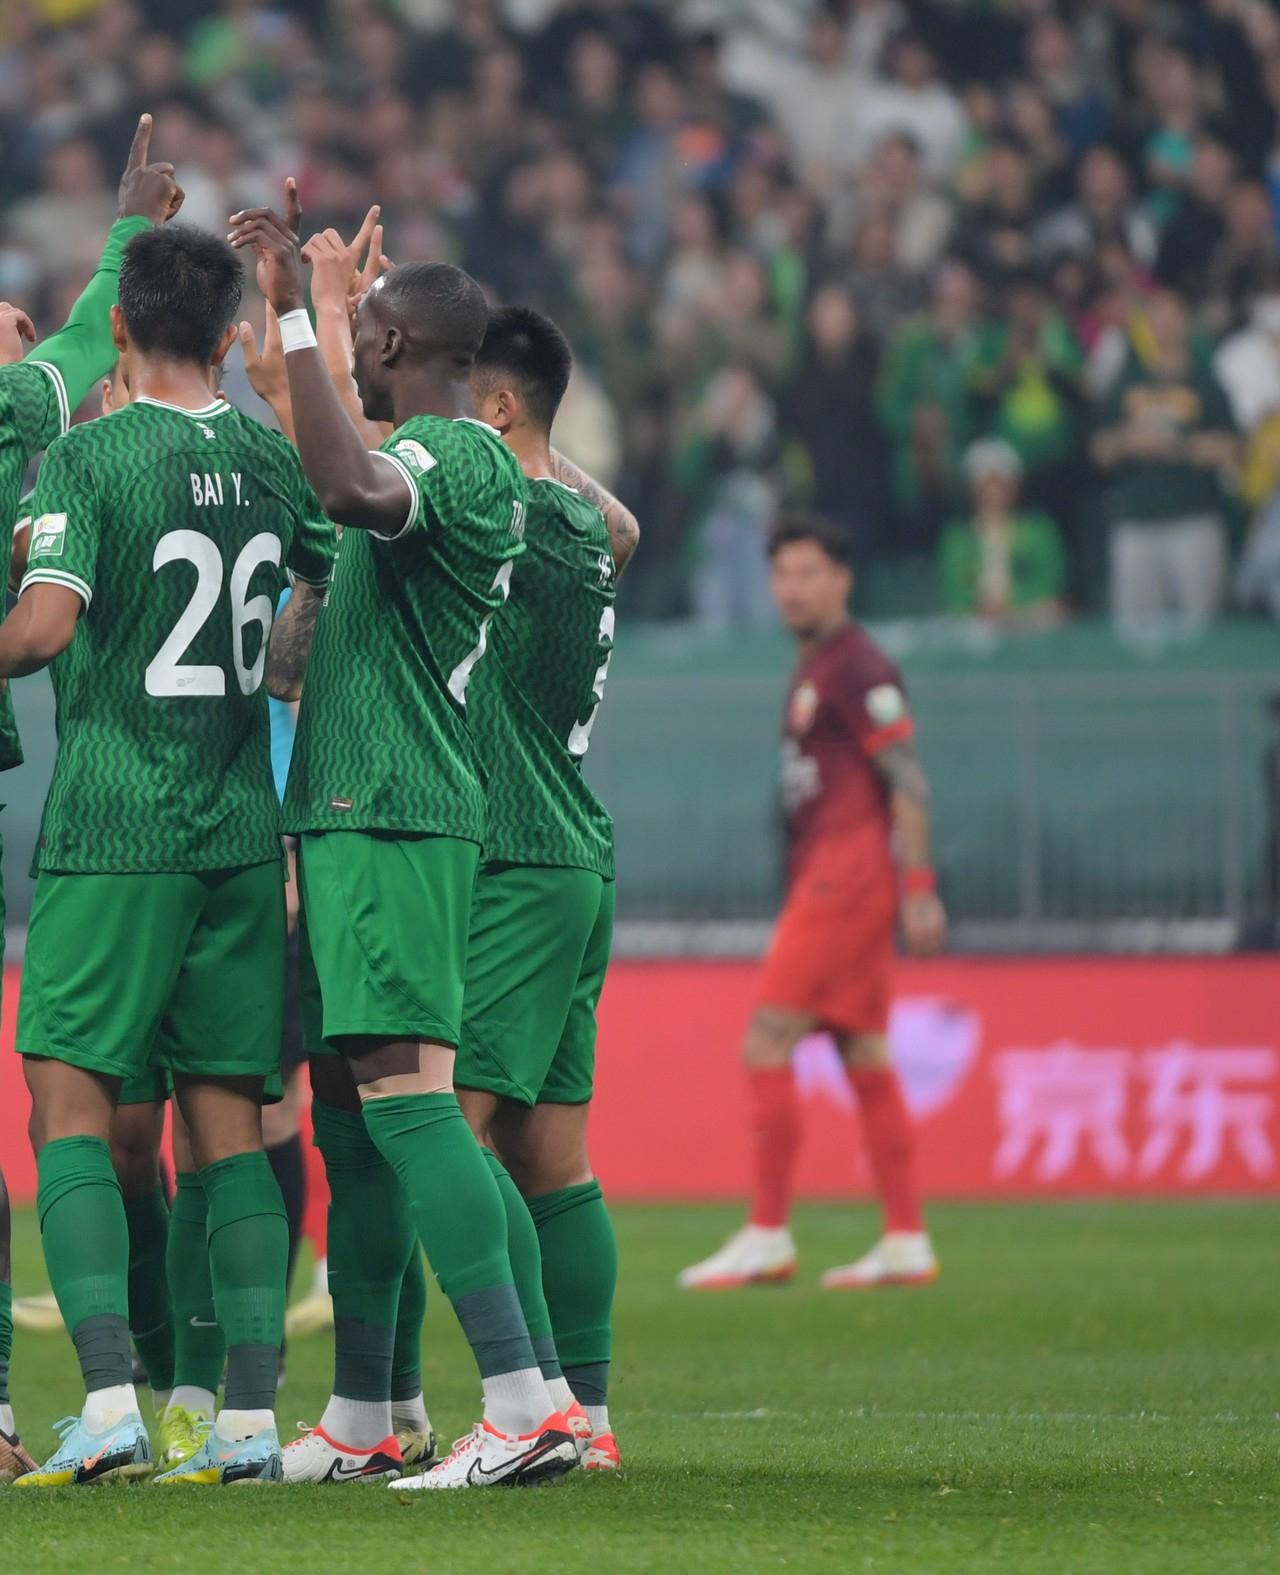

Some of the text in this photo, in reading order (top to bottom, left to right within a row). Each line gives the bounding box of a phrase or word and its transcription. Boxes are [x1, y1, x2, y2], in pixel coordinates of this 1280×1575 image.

[190, 472, 250, 506] BAI Y.
[144, 529, 282, 697] 26
[990, 1039, 1280, 1182] 京东
